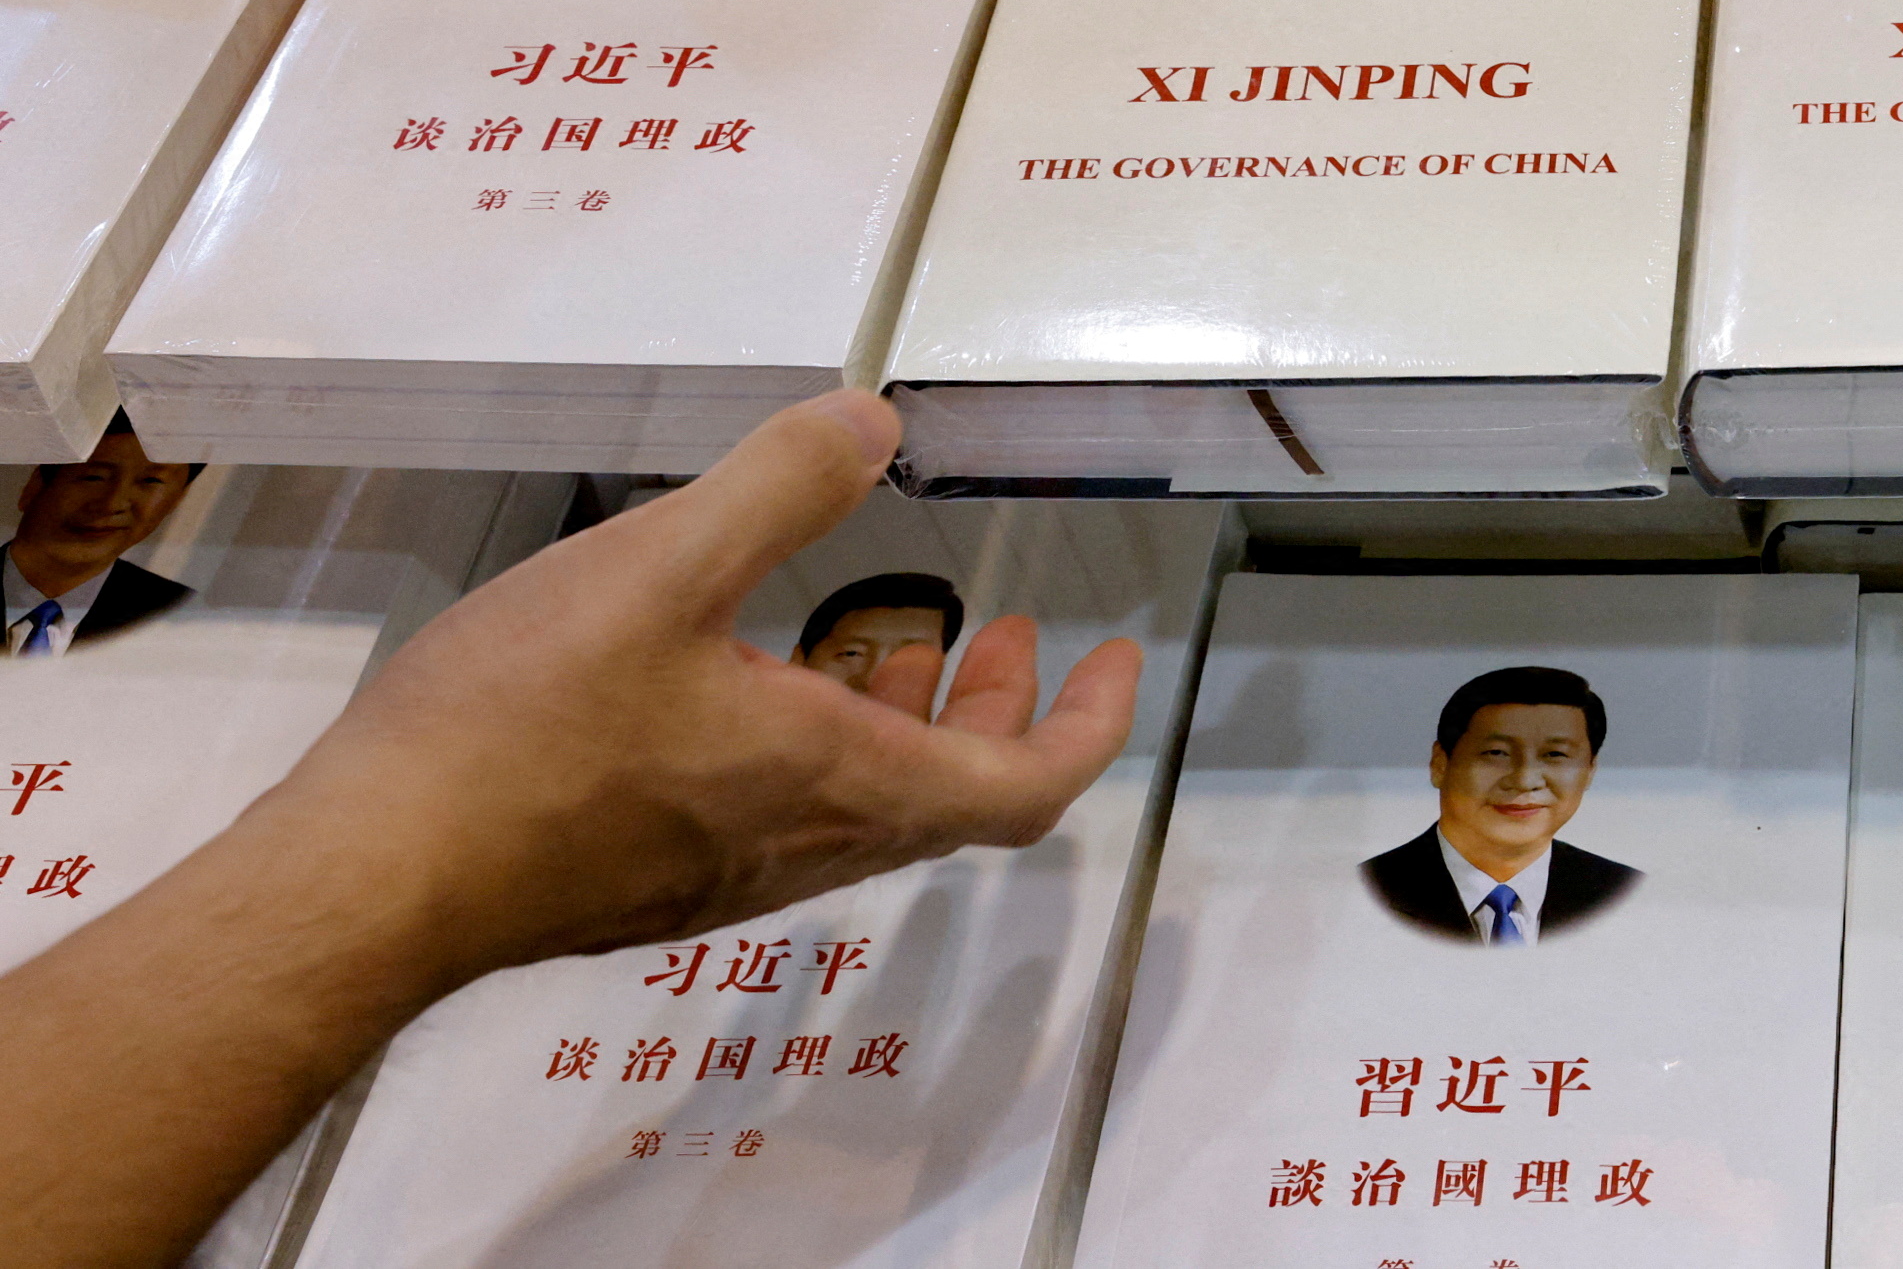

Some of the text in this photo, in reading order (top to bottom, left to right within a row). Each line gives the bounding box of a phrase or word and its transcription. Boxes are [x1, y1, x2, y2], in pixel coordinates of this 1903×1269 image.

[490, 41, 720, 88] 习近平
[1128, 61, 1533, 103] XI JINPING
[392, 115, 757, 154] 谈治国理政
[1793, 102, 1878, 125] THE
[1018, 152, 1619, 181] THE GOVERNANCE OF CHINA
[475, 188, 612, 212] 第三卷
[643, 937, 873, 997] 习近平
[544, 1032, 910, 1083] 谈治国理政
[1354, 1055, 1594, 1118] 習近平
[623, 1128, 767, 1159] 第三卷
[1267, 1158, 1656, 1208] 談治國理政
